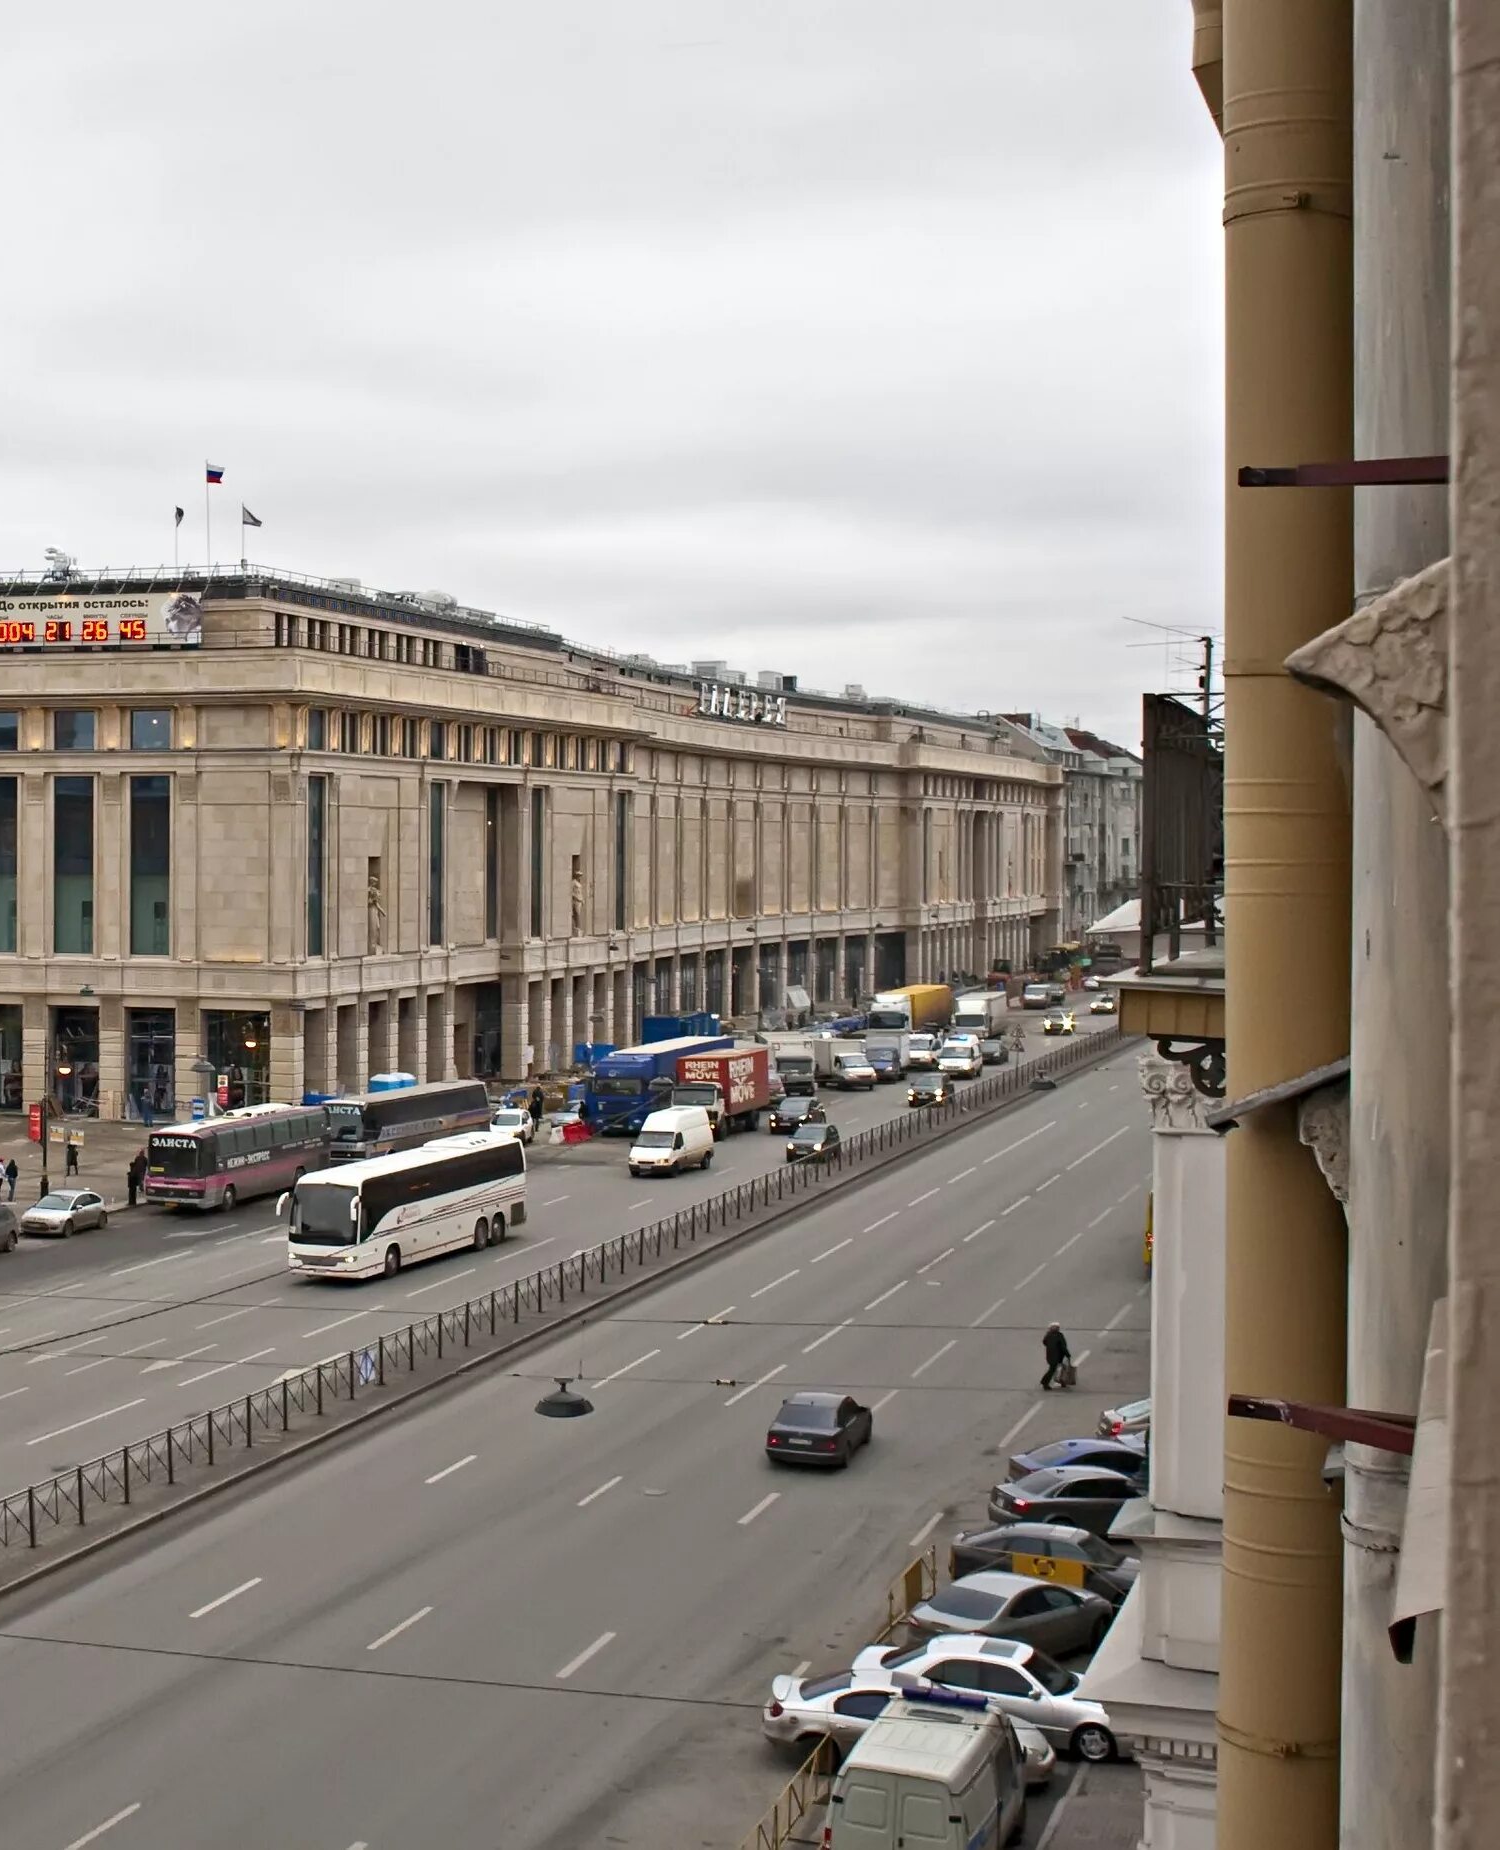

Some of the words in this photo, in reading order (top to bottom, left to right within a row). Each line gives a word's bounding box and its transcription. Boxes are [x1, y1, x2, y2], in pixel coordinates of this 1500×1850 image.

[18, 601, 80, 611] открытия
[83, 599, 149, 609] осталось:
[46, 621, 71, 641] 21
[83, 620, 108, 640] 26
[119, 619, 145, 640] 45
[684, 1060, 719, 1070] RHEIN
[728, 1056, 754, 1079] RHEIN
[684, 1071, 720, 1079] MOVE
[730, 1083, 755, 1104] MOVE
[152, 1137, 197, 1149] ЭЛИСТА
